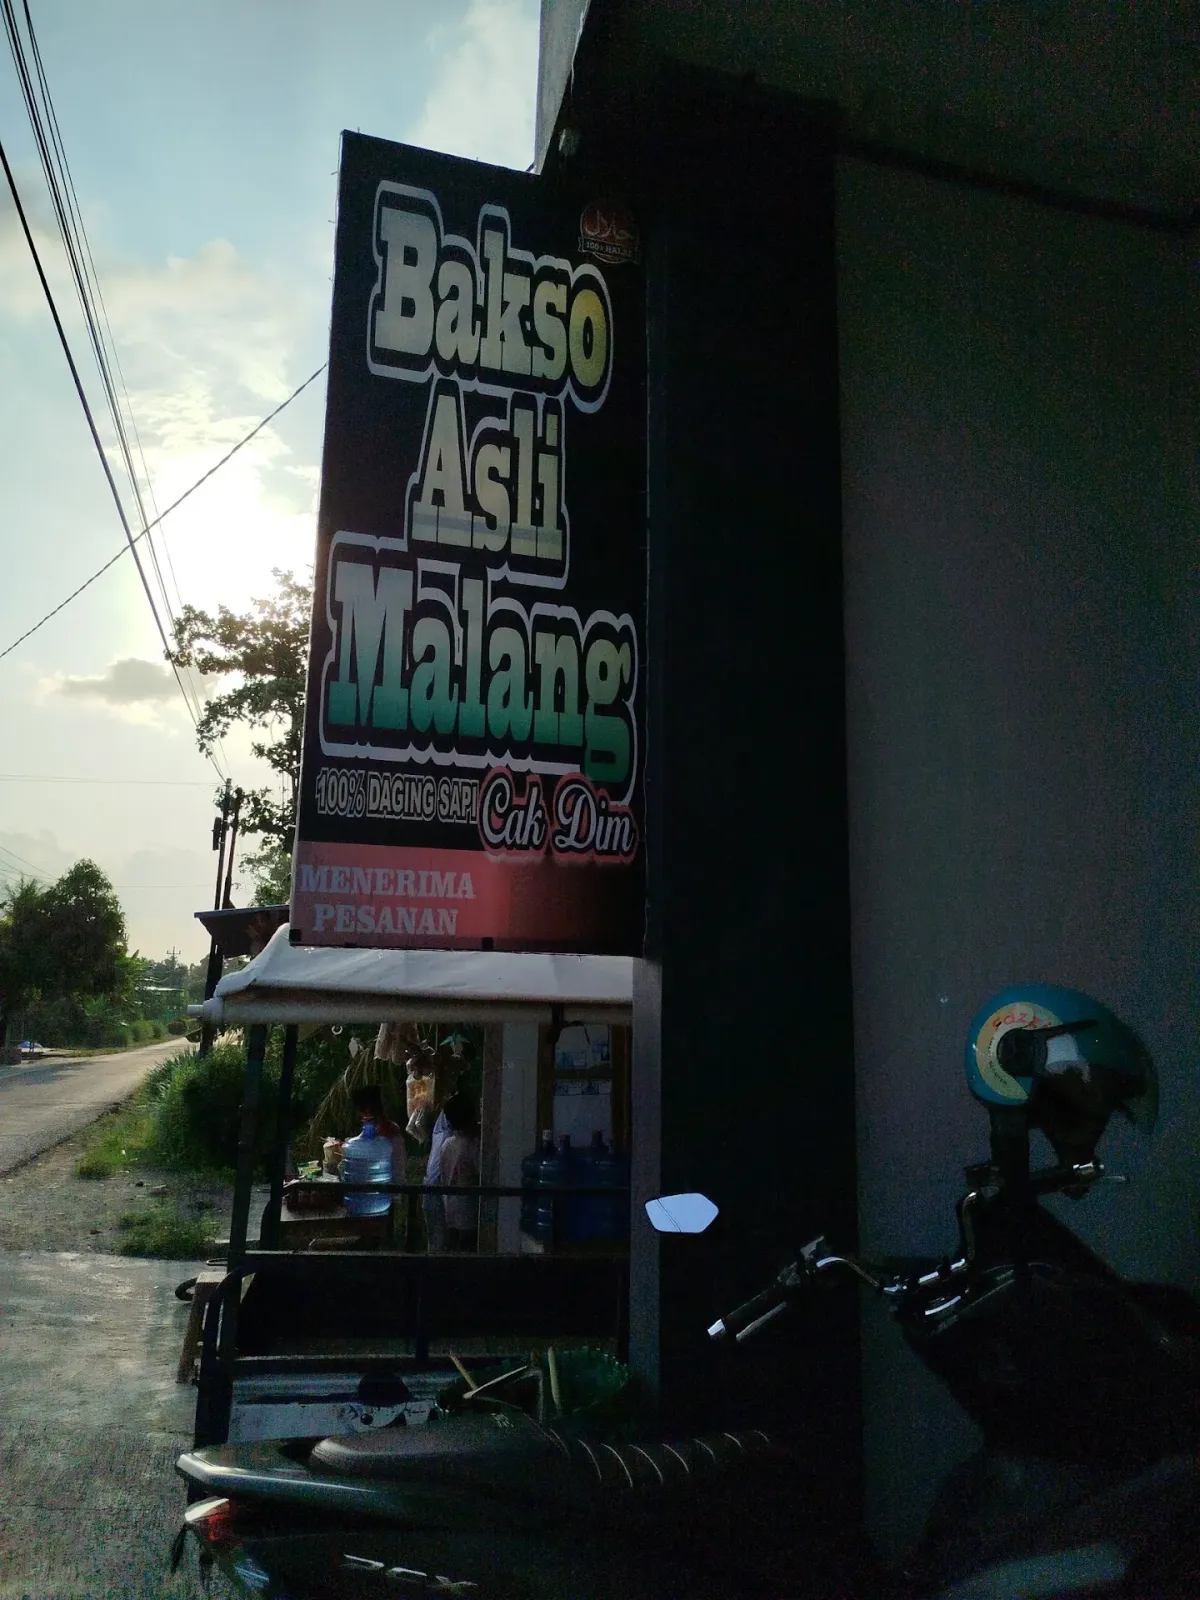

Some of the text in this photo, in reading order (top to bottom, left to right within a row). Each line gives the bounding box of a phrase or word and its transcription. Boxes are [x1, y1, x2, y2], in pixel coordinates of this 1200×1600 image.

[373, 206, 607, 388] Bakso
[412, 394, 563, 560] Asli
[328, 560, 632, 784] Malang
[317, 768, 480, 824] 100% DAGING SAPI
[483, 777, 635, 852] Cak Dim
[300, 863, 476, 900] MENERIMA
[312, 902, 459, 936] PESANAN
